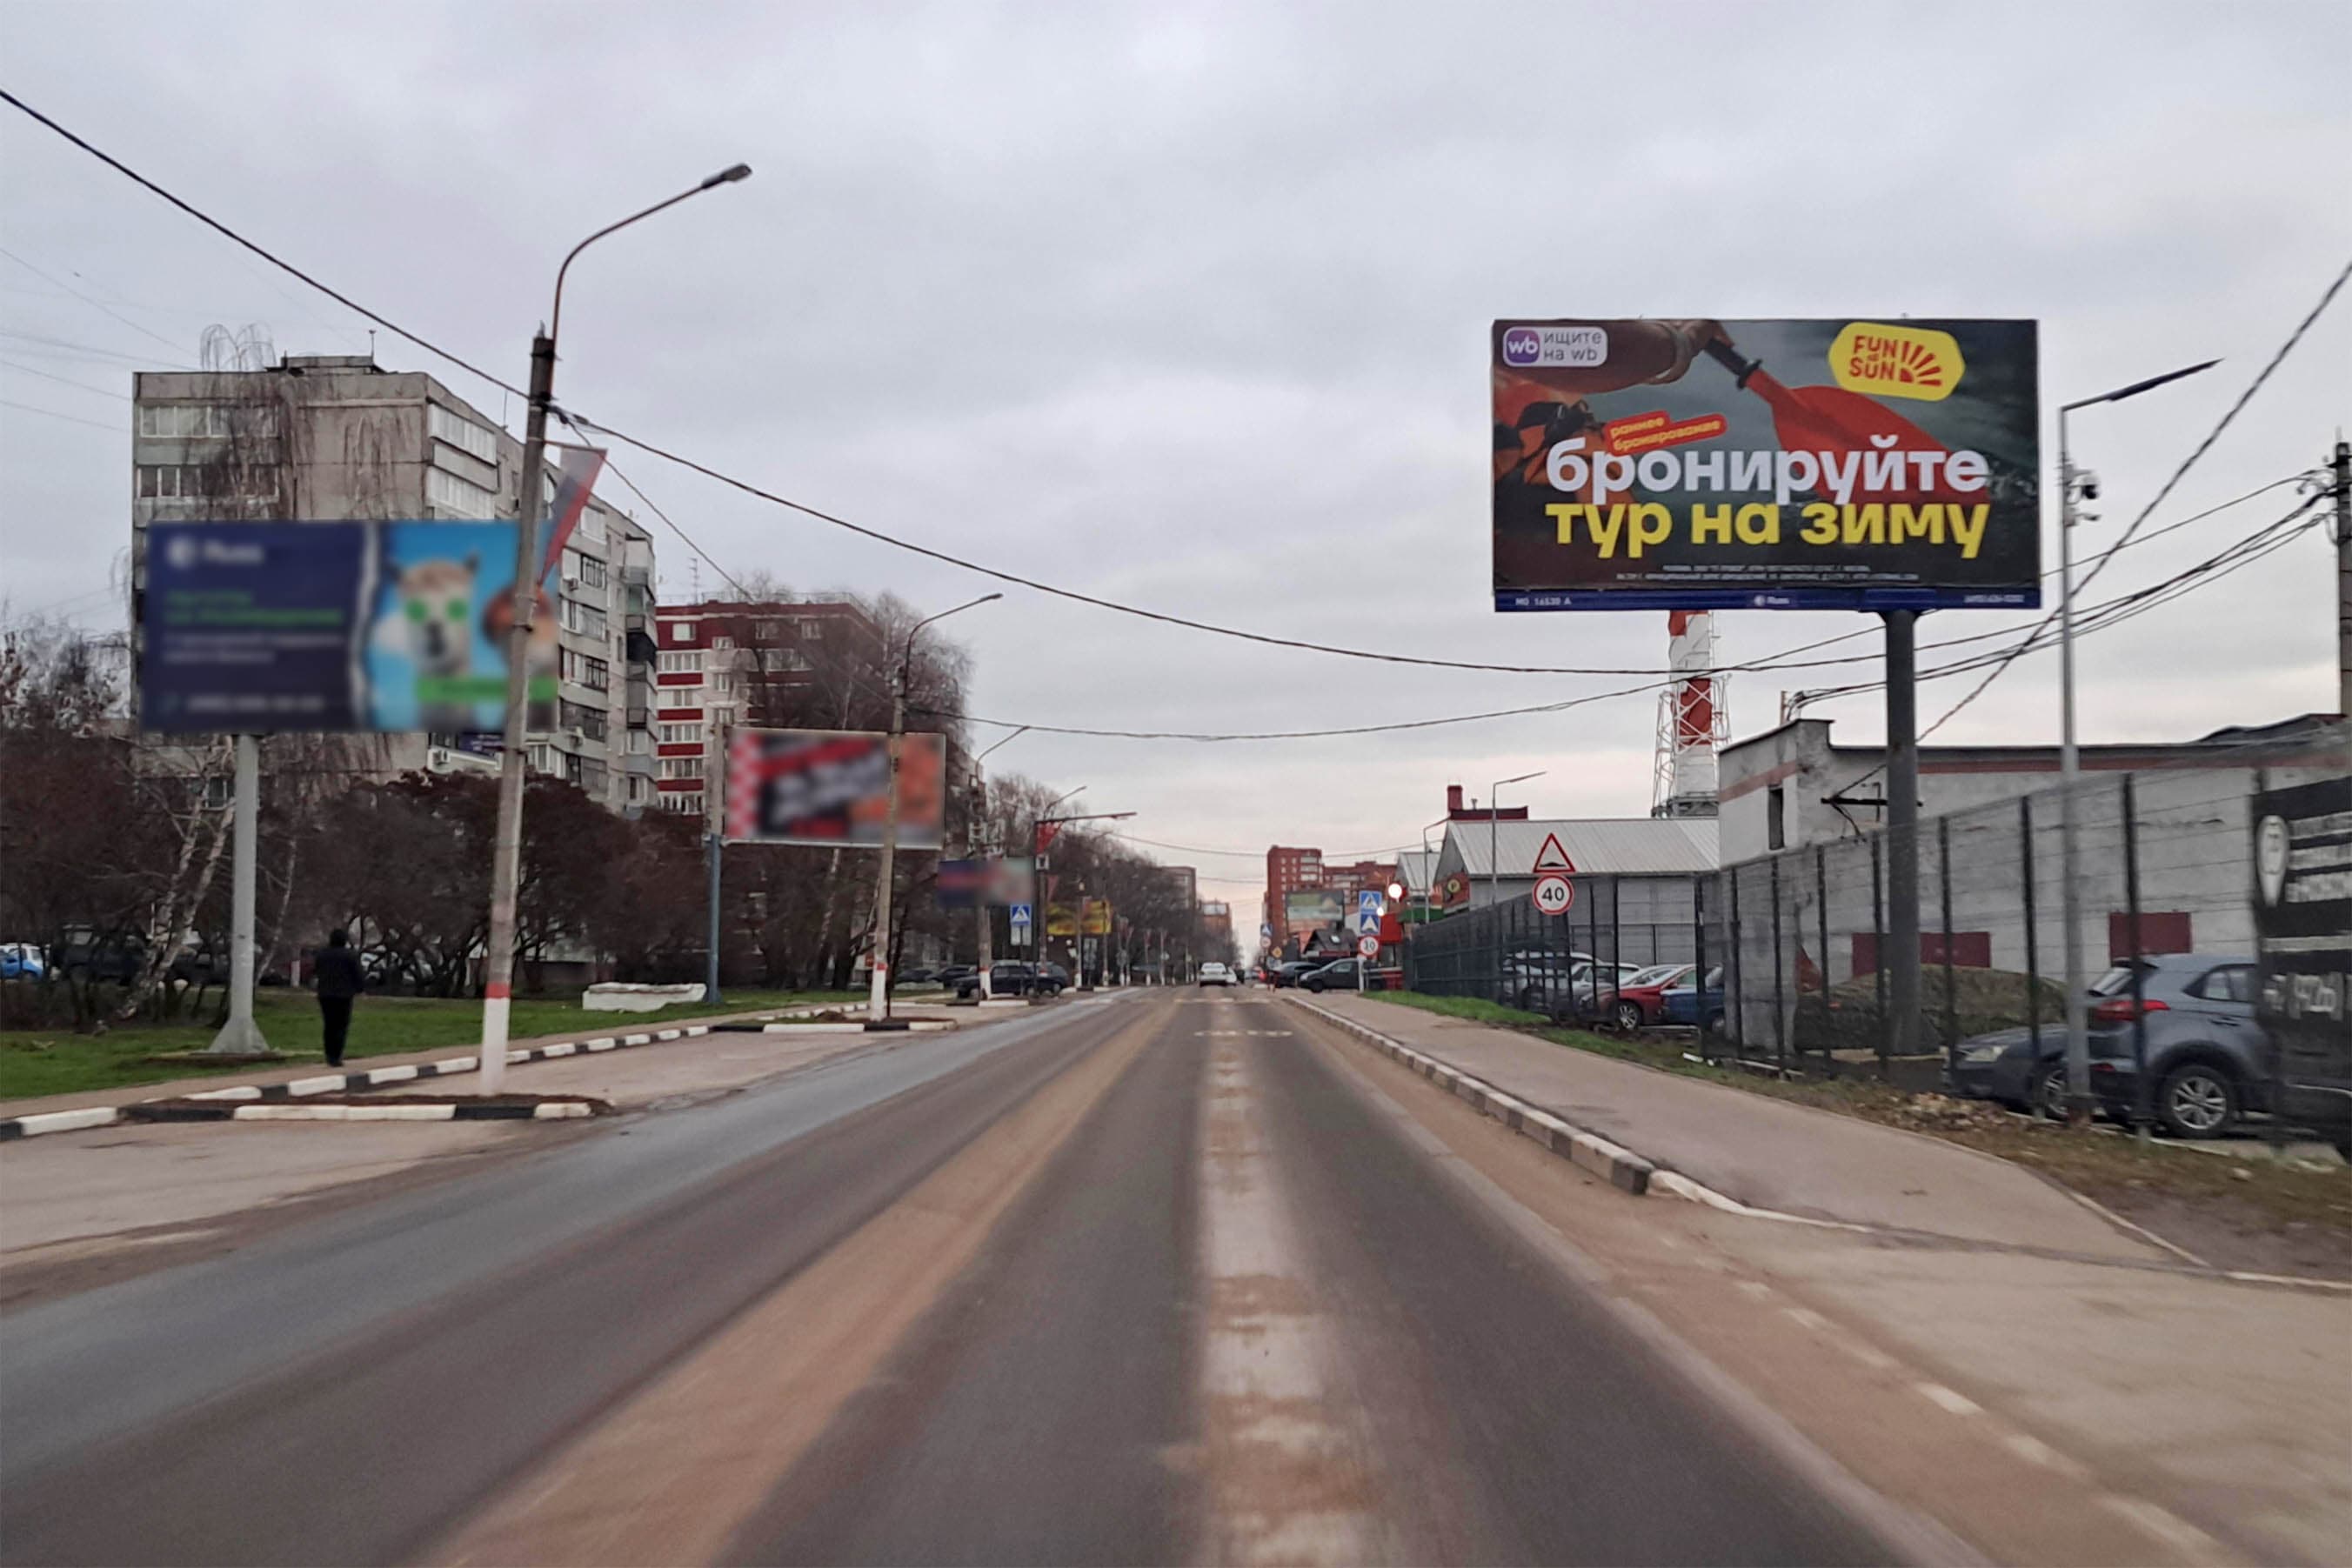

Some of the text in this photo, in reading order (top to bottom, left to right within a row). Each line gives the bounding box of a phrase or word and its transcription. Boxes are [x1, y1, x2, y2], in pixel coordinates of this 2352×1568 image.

[1507, 335, 1539, 355] wb
[1544, 332, 1601, 345] ищите
[1854, 335, 1898, 358] FUN
[1544, 349, 1598, 361] на wb
[1849, 357, 1894, 381] SUN
[1547, 435, 1989, 506] бронируйте
[1546, 503, 1990, 558] тур на зиму
[1541, 886, 1565, 902] 40
